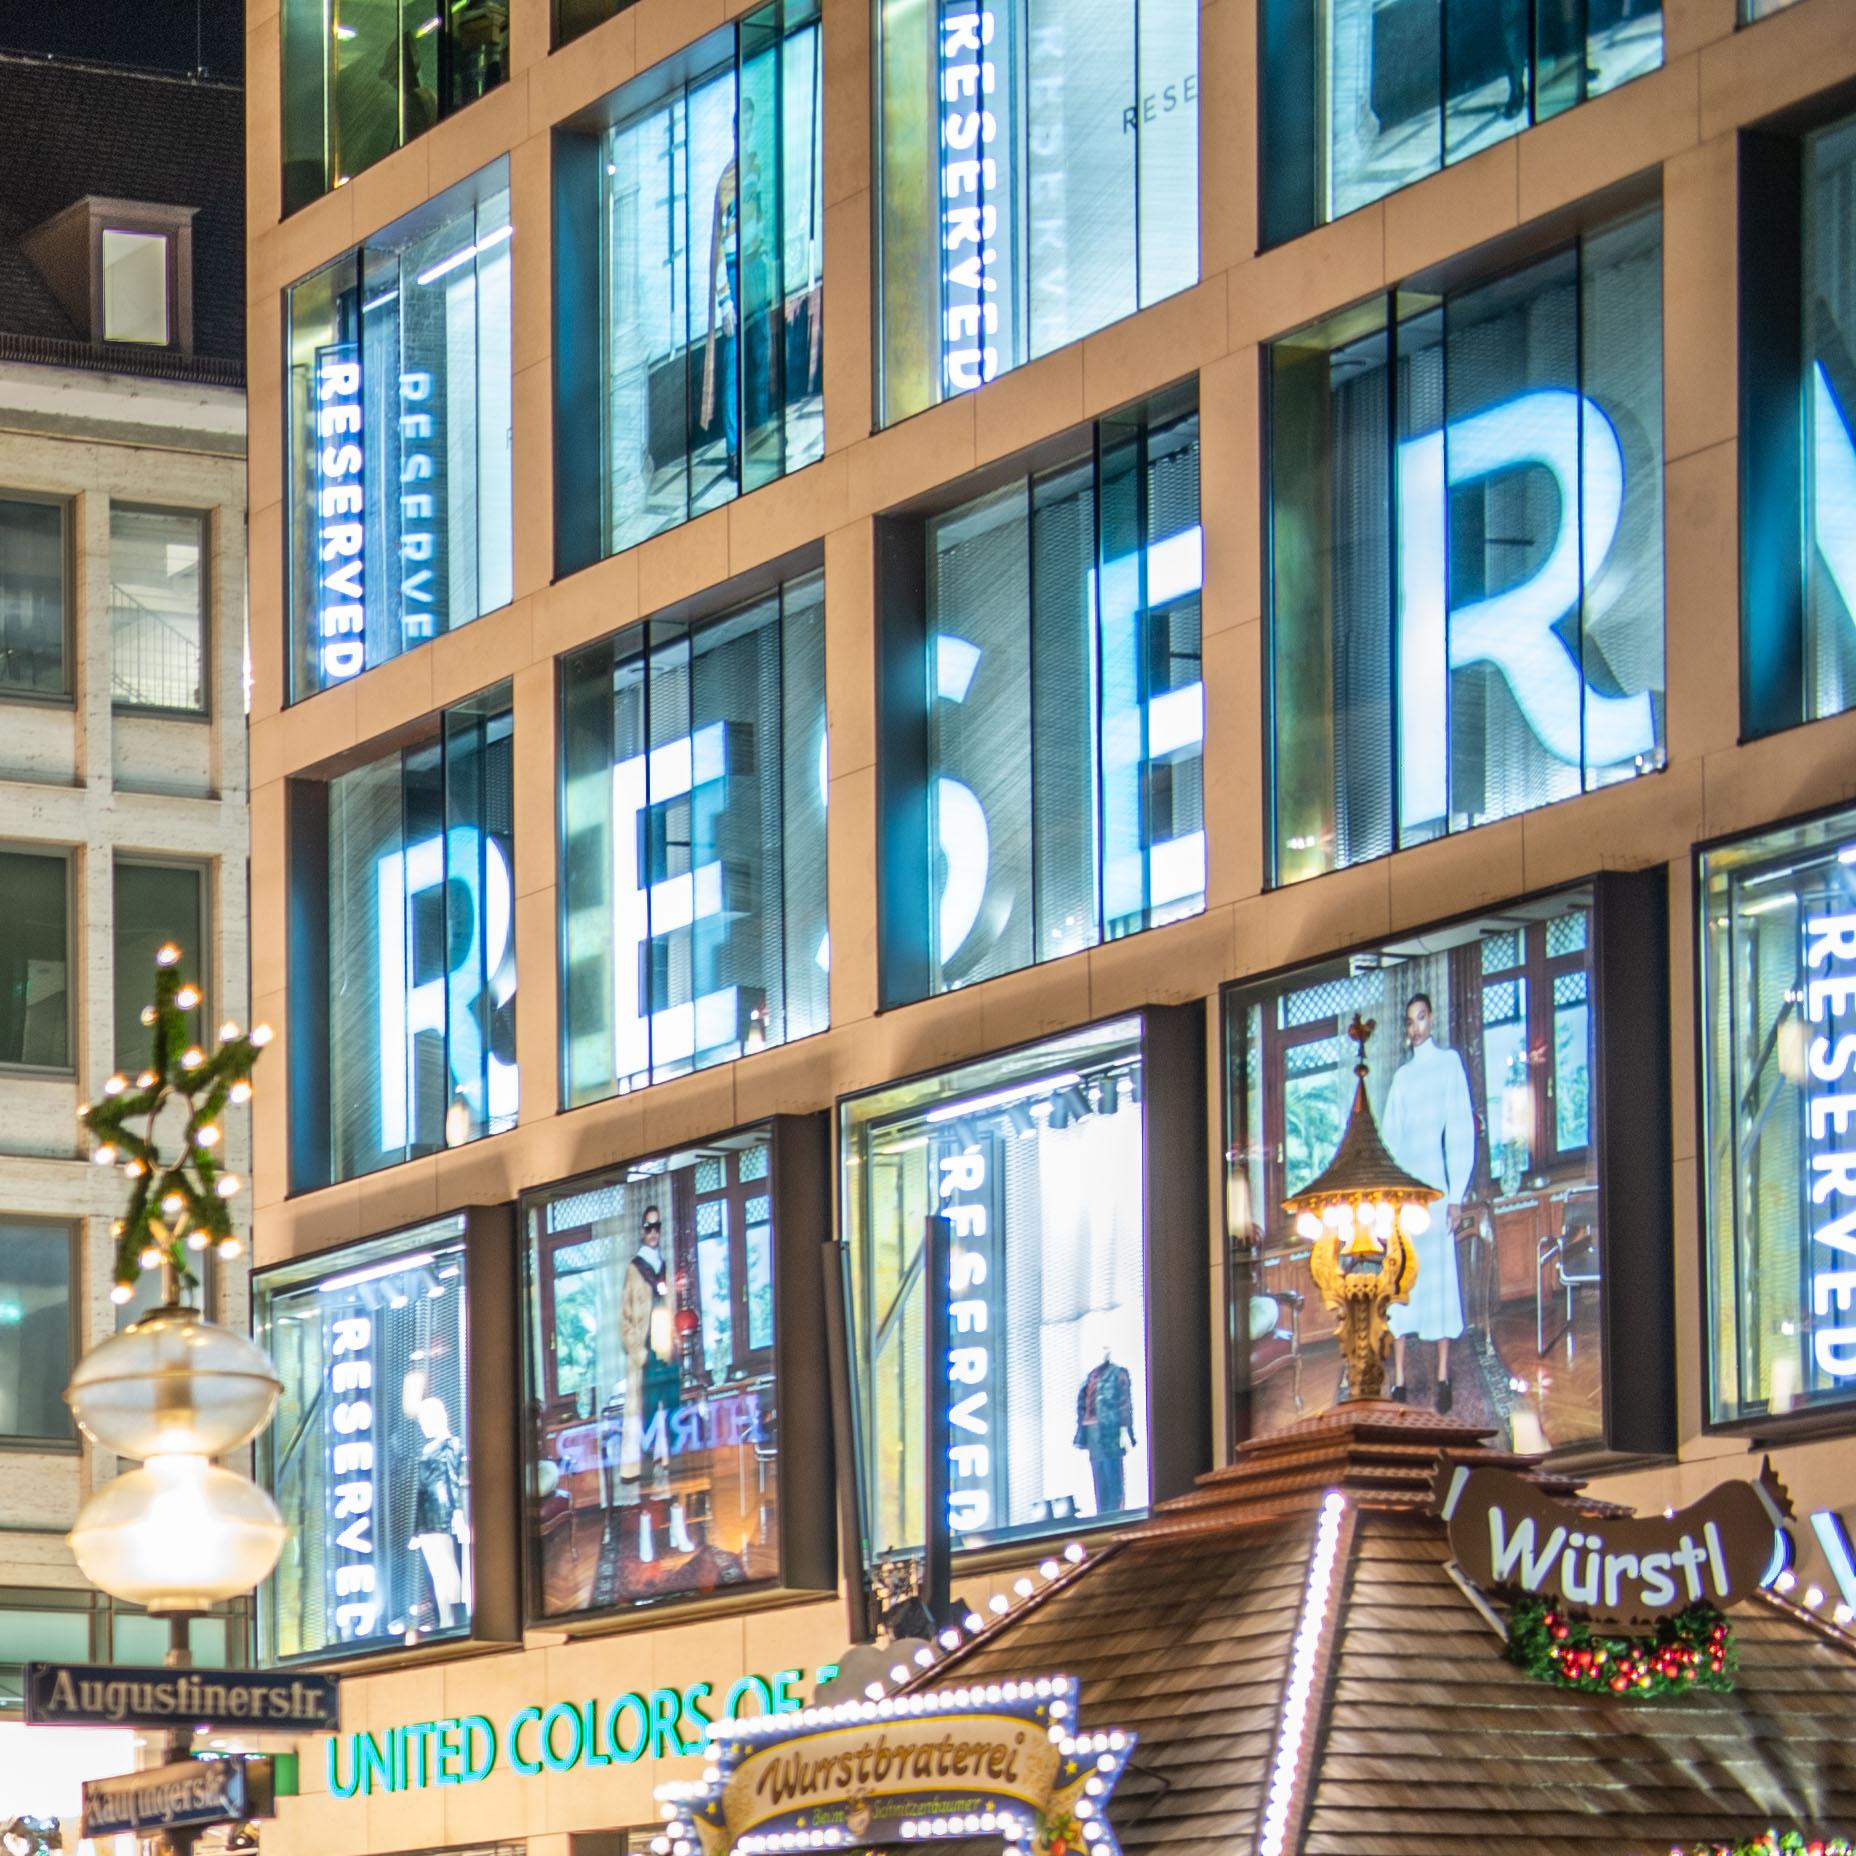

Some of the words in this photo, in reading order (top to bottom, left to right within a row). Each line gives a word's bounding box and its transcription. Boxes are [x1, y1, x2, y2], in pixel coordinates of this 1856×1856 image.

[943, 12, 998, 389] RESERVED
[321, 362, 365, 677] RESERVED
[1808, 912, 1856, 1380] RESERVED
[1488, 1504, 1730, 1608] Würstl
[48, 1669, 328, 1721] Augustinerstr.
[325, 1715, 497, 1799] UNITED
[506, 1682, 710, 1777] COLORS
[755, 1731, 1025, 1806] Wurstbraterei
